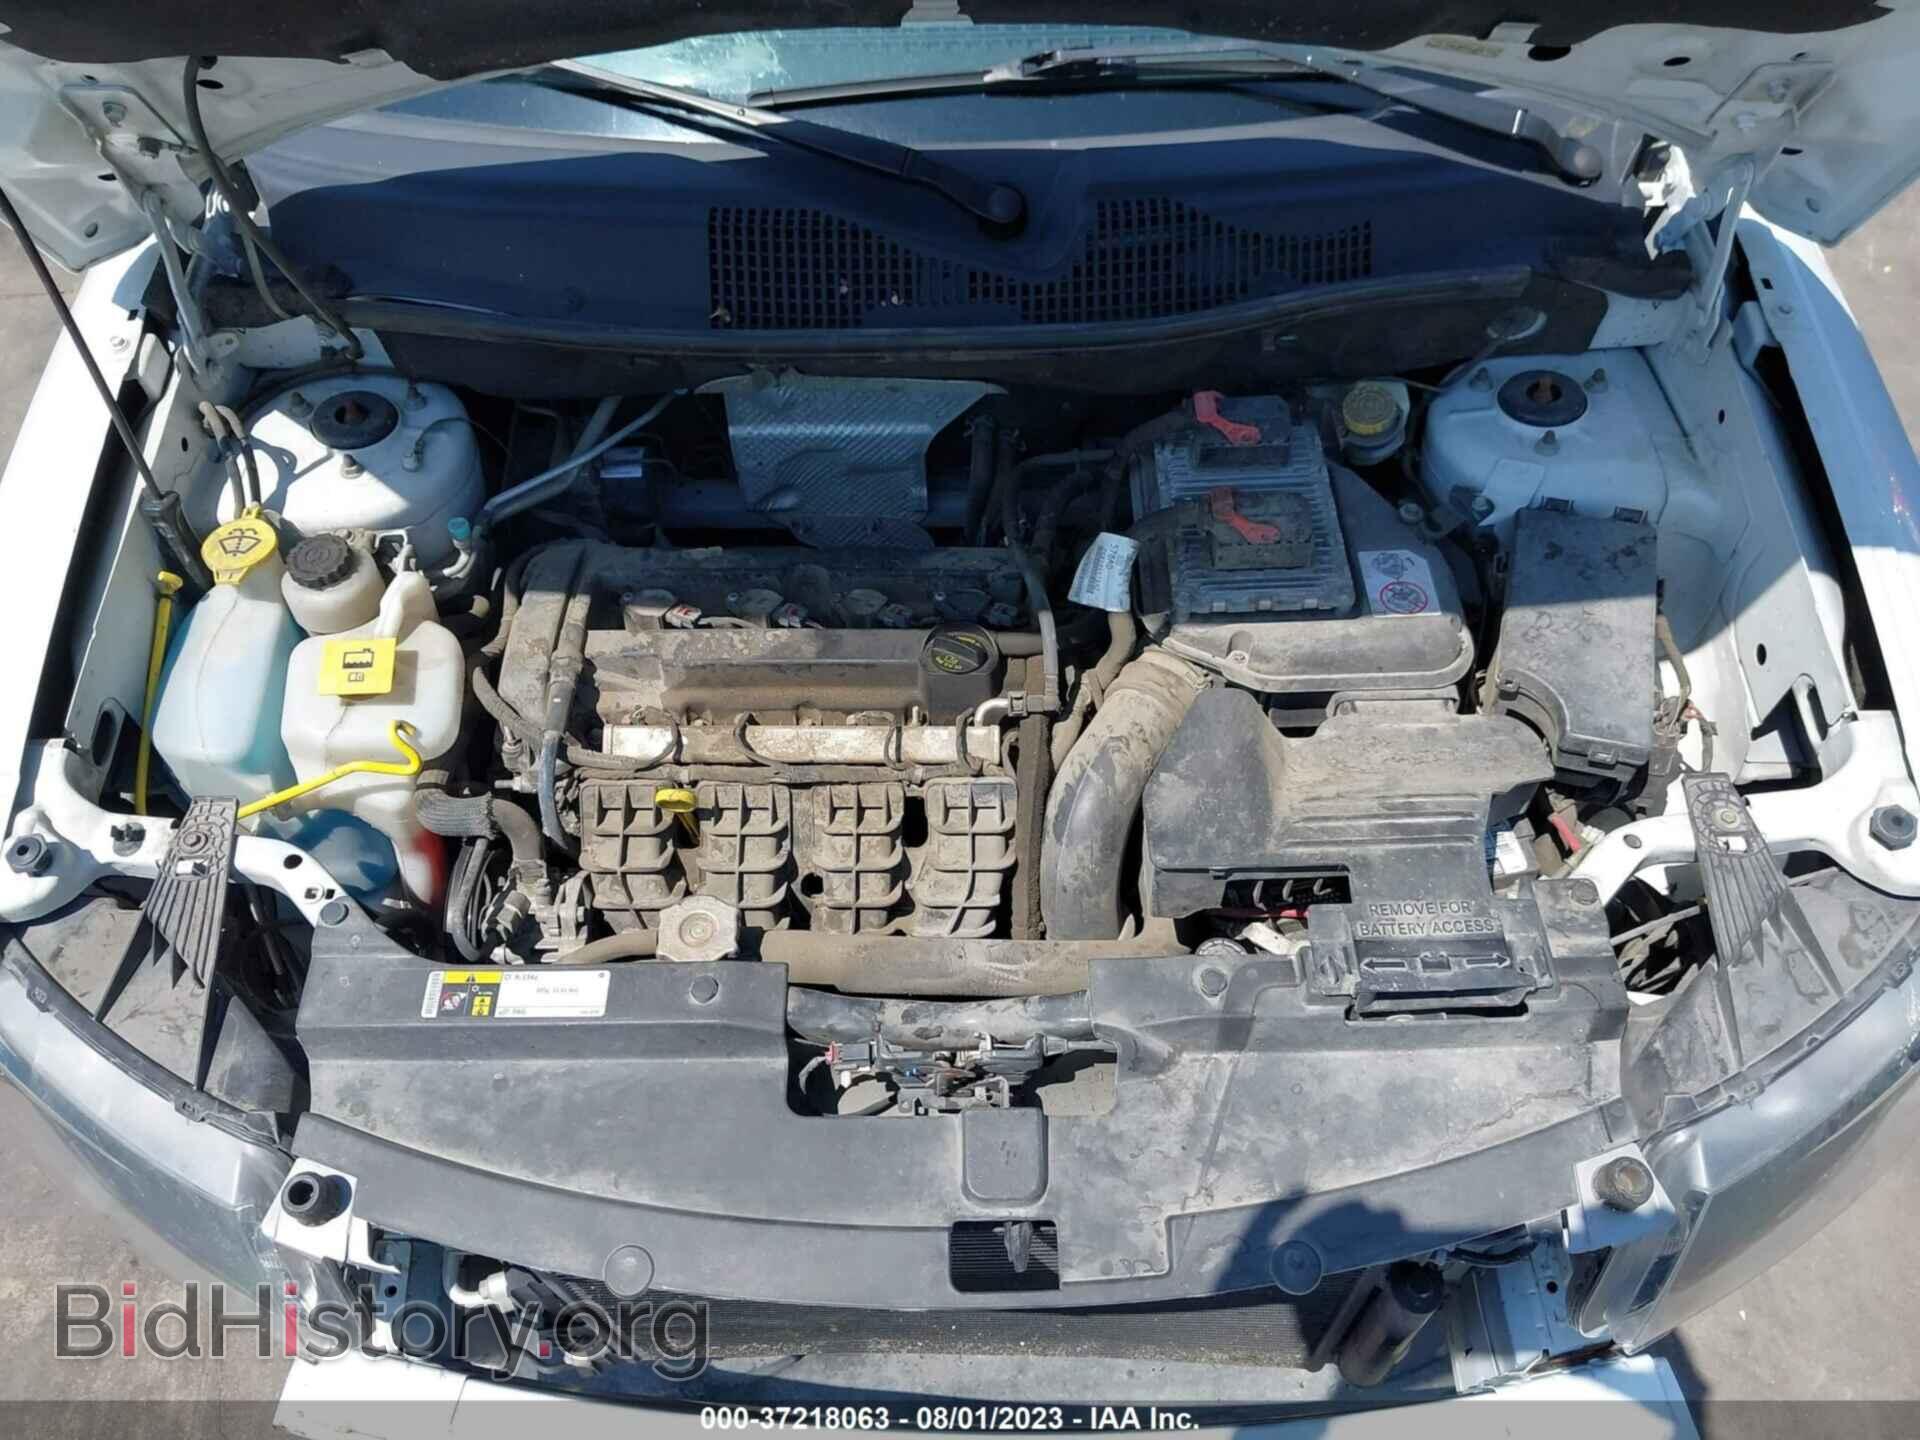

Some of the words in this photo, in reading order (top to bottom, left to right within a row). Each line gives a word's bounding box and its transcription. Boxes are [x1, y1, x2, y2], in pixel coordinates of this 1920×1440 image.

[1369, 901, 1435, 916] REMOVE
[1439, 900, 1472, 914] FOR
[1358, 922, 1426, 937] BATTERY
[1432, 919, 1495, 934] ACCESS
